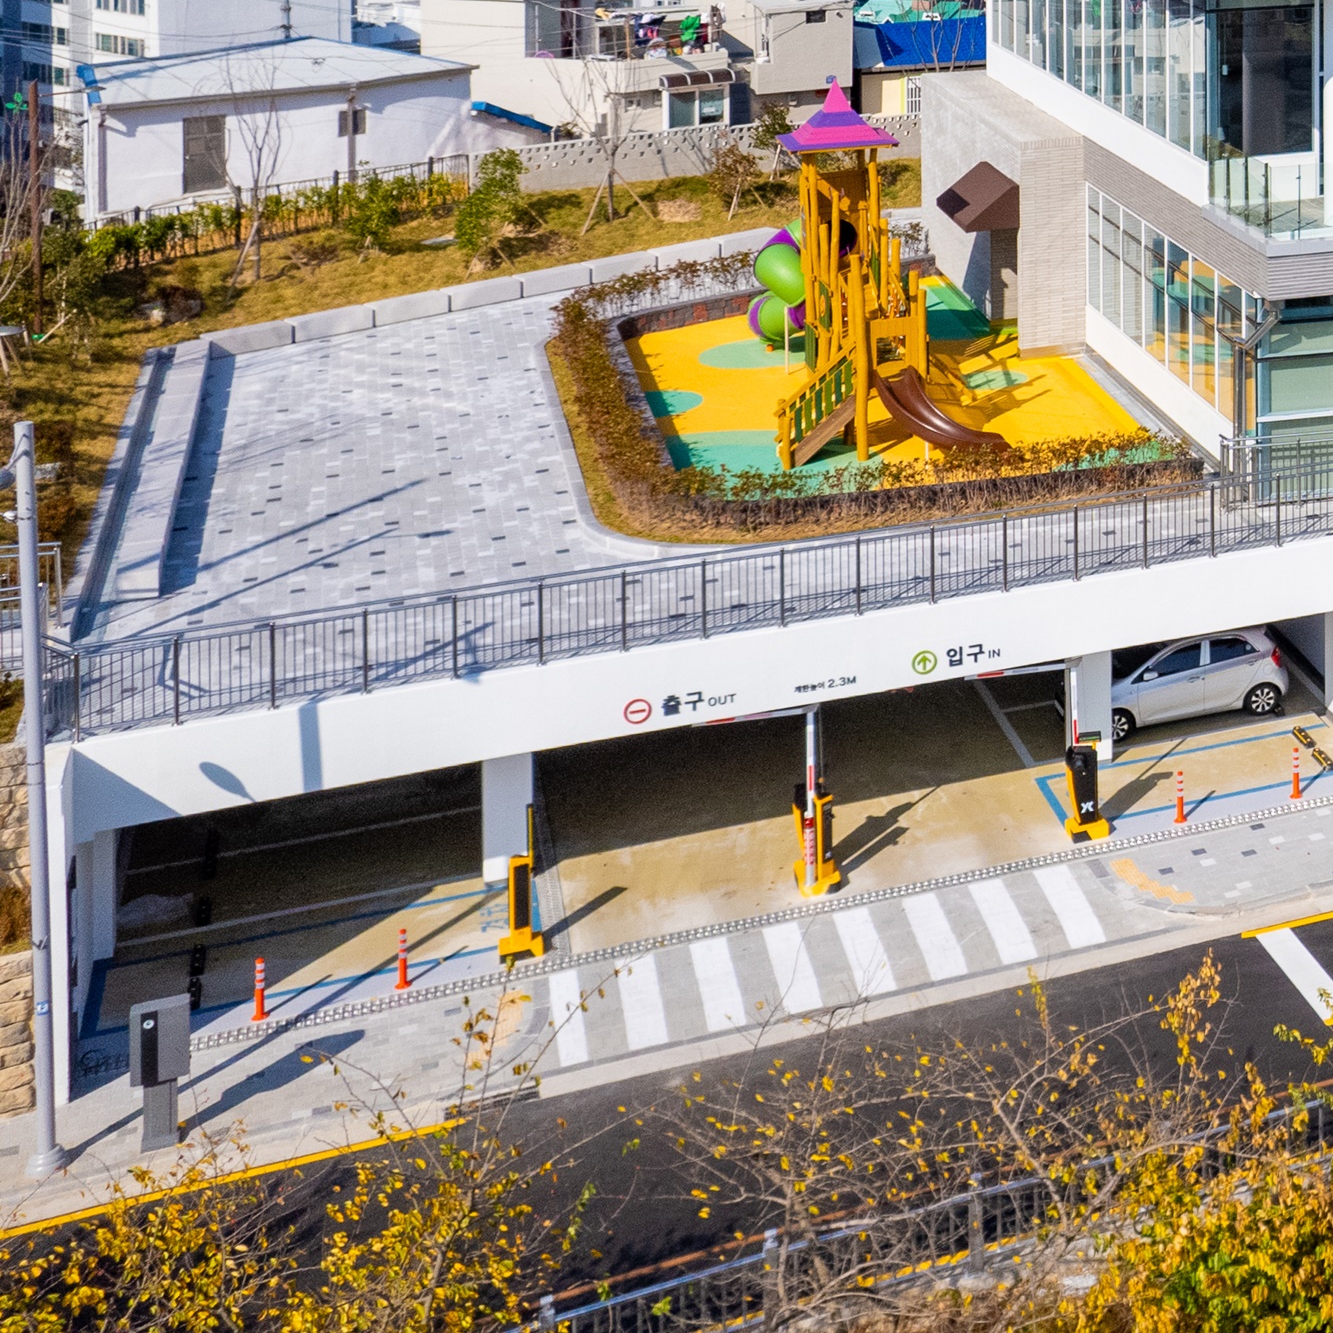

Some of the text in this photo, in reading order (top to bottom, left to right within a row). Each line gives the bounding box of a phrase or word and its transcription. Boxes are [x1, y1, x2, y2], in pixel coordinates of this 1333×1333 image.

[946, 643, 1001, 667] 입구 IN
[828, 676, 857, 688] 2.3M
[661, 691, 736, 716] 출구 OUT
